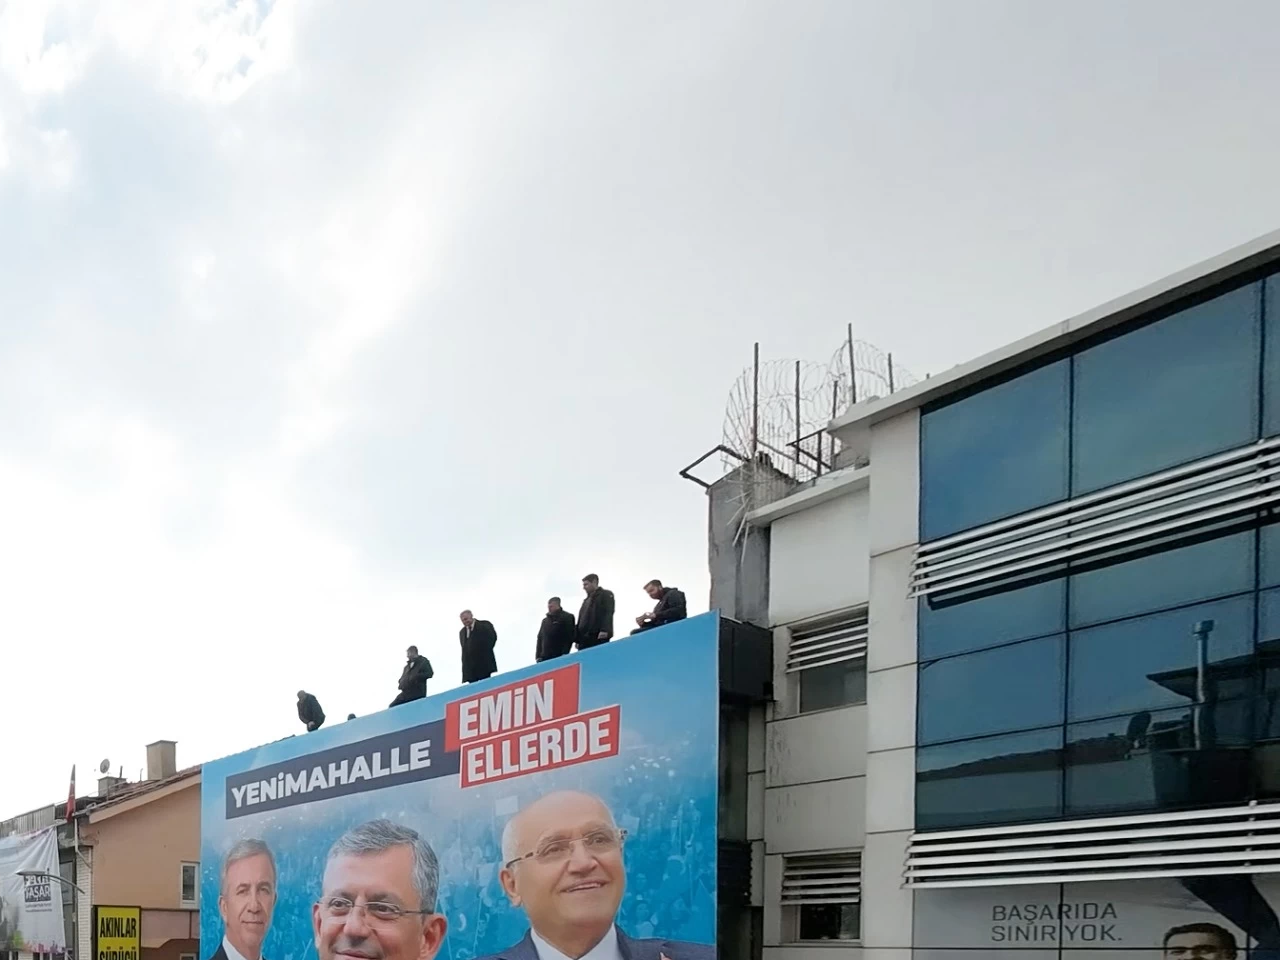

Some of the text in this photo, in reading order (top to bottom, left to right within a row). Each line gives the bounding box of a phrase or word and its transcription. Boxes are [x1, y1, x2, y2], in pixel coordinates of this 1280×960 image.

[468, 713, 611, 783] ELLERDE
[992, 902, 1118, 926] BAŞARIDA
[100, 917, 137, 938] AKINLAR
[1064, 924, 1122, 942] YOK.
